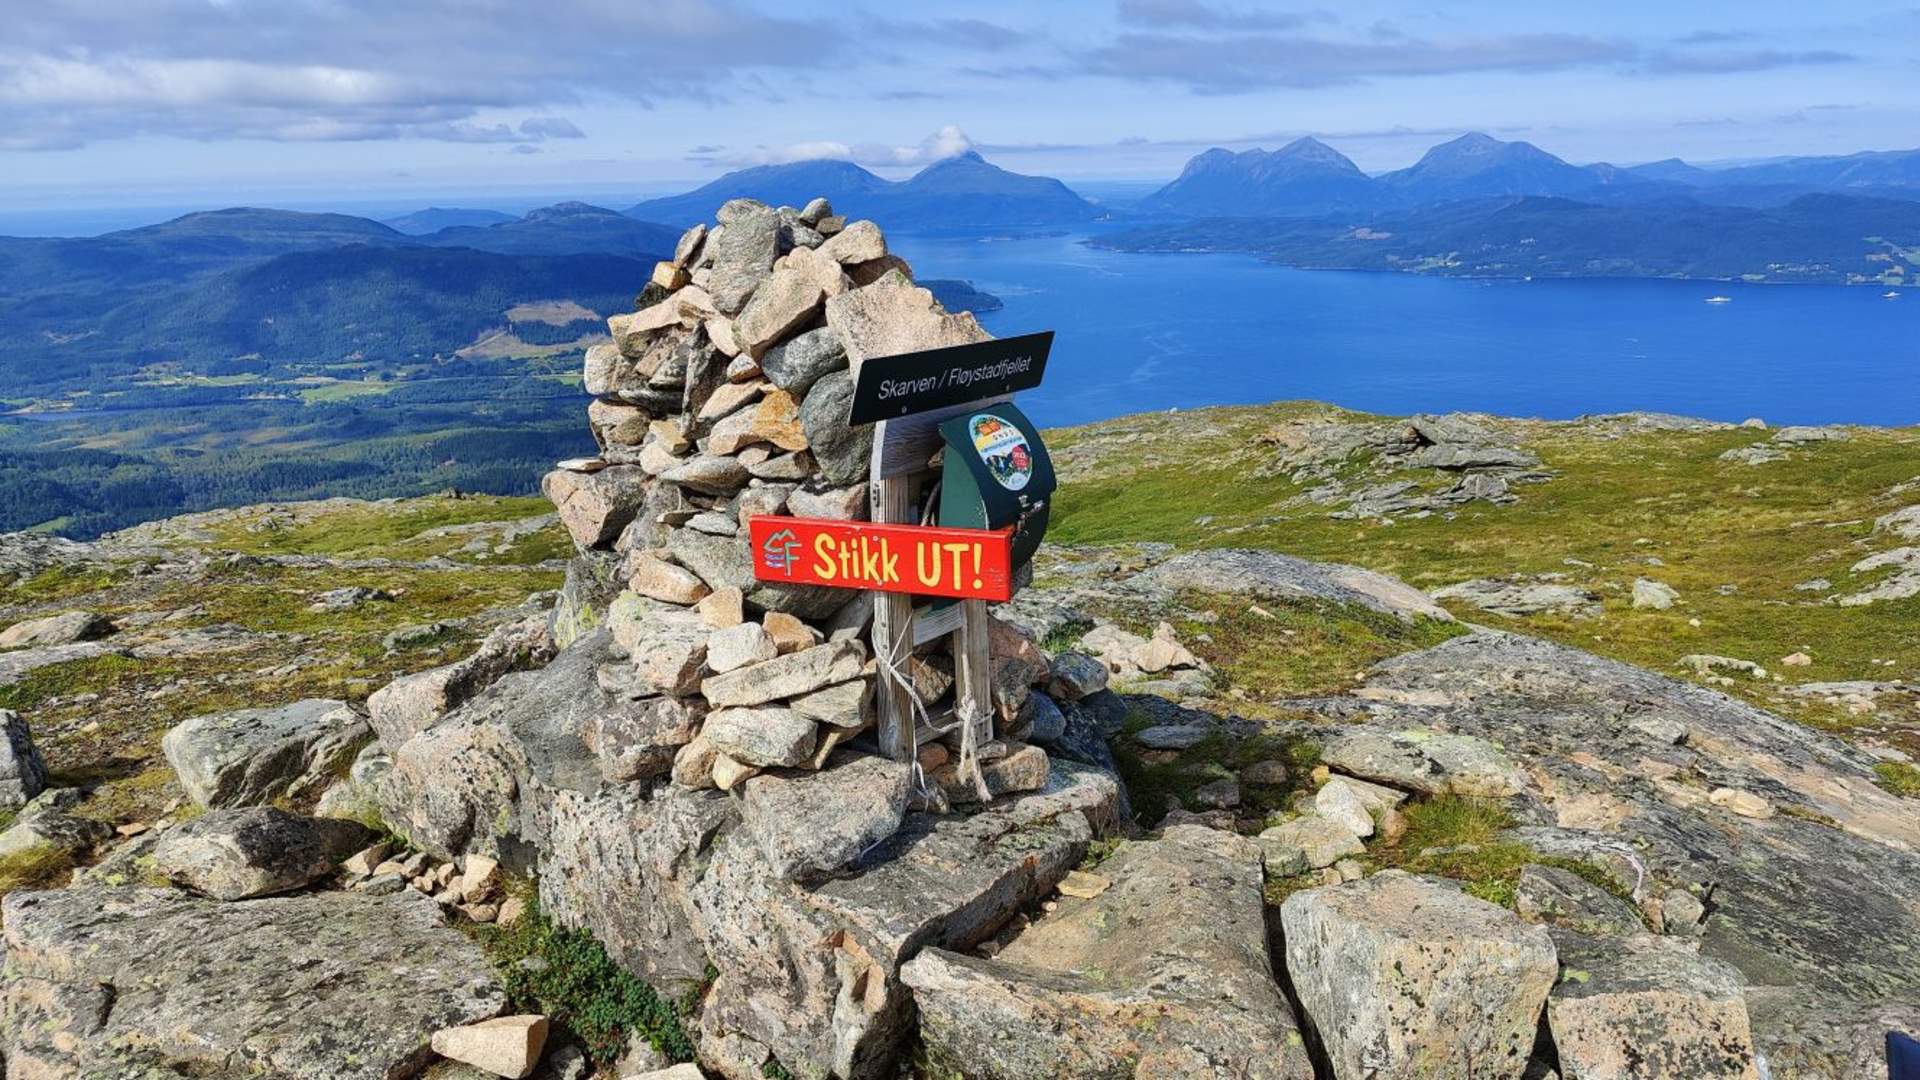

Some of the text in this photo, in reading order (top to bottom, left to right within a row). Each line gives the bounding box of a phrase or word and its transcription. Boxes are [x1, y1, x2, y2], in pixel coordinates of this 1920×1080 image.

[878, 355, 1032, 400] Skarven / Fløystadfjellet
[813, 532, 983, 590] Stikk UT!
